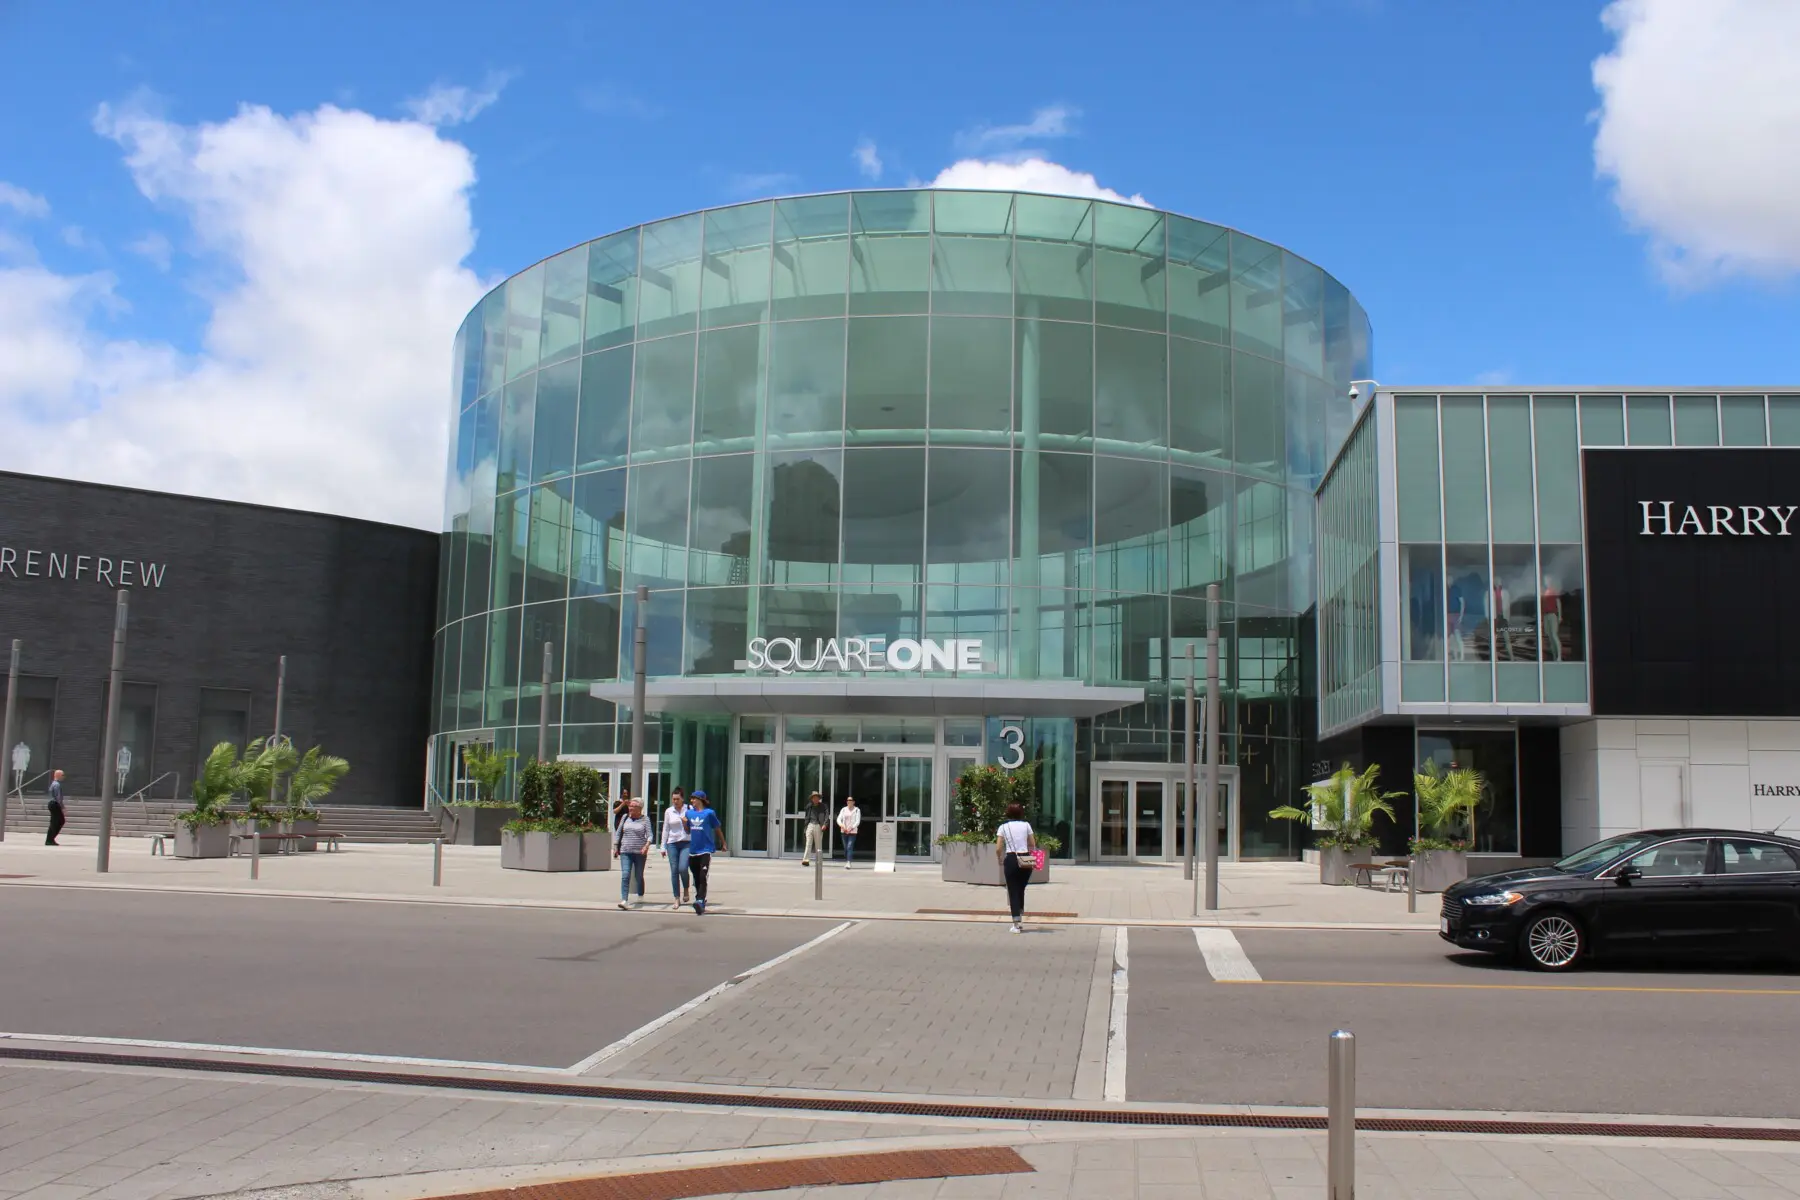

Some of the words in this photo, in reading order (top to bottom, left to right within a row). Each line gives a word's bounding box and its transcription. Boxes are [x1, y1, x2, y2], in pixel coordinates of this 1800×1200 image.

[1638, 501, 1798, 535] HARRY
[0, 547, 166, 588] RENFREW
[997, 725, 1025, 769] 3
[1753, 784, 1800, 796] HARRY
